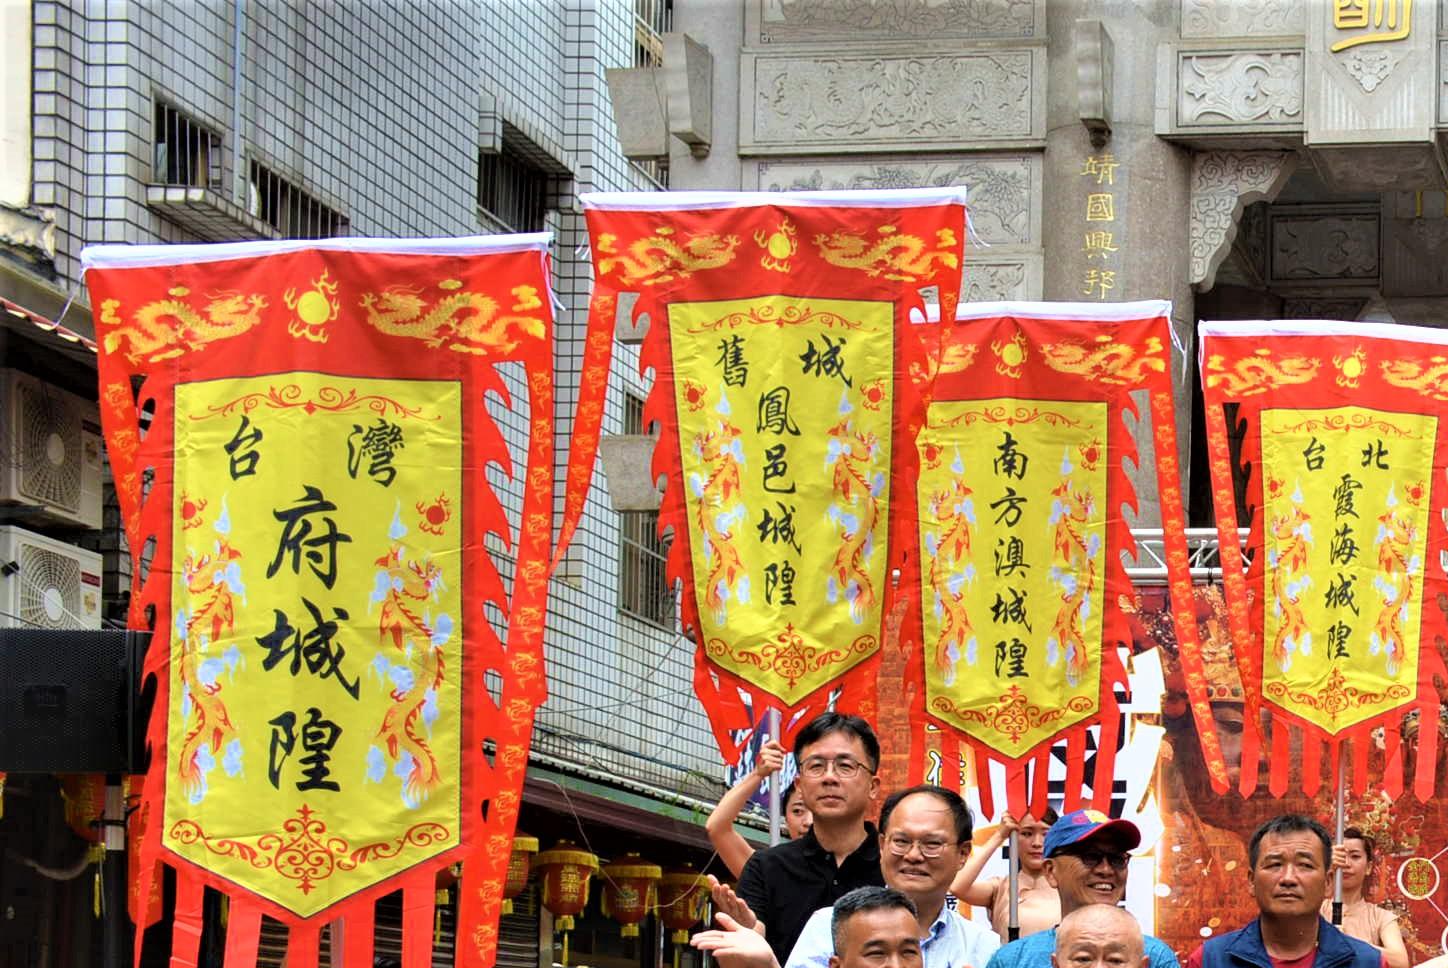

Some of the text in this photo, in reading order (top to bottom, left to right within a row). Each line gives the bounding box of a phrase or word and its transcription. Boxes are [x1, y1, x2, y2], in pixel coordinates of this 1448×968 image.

[223, 414, 406, 488] 台灣
[713, 333, 852, 388] 舊城
[1302, 436, 1390, 472] 台北
[755, 385, 801, 607] 鳳邑城隍
[989, 430, 1032, 679] 南方澳城隍
[1324, 473, 1364, 660] 霞海城隍
[255, 484, 360, 793] 府城隍
